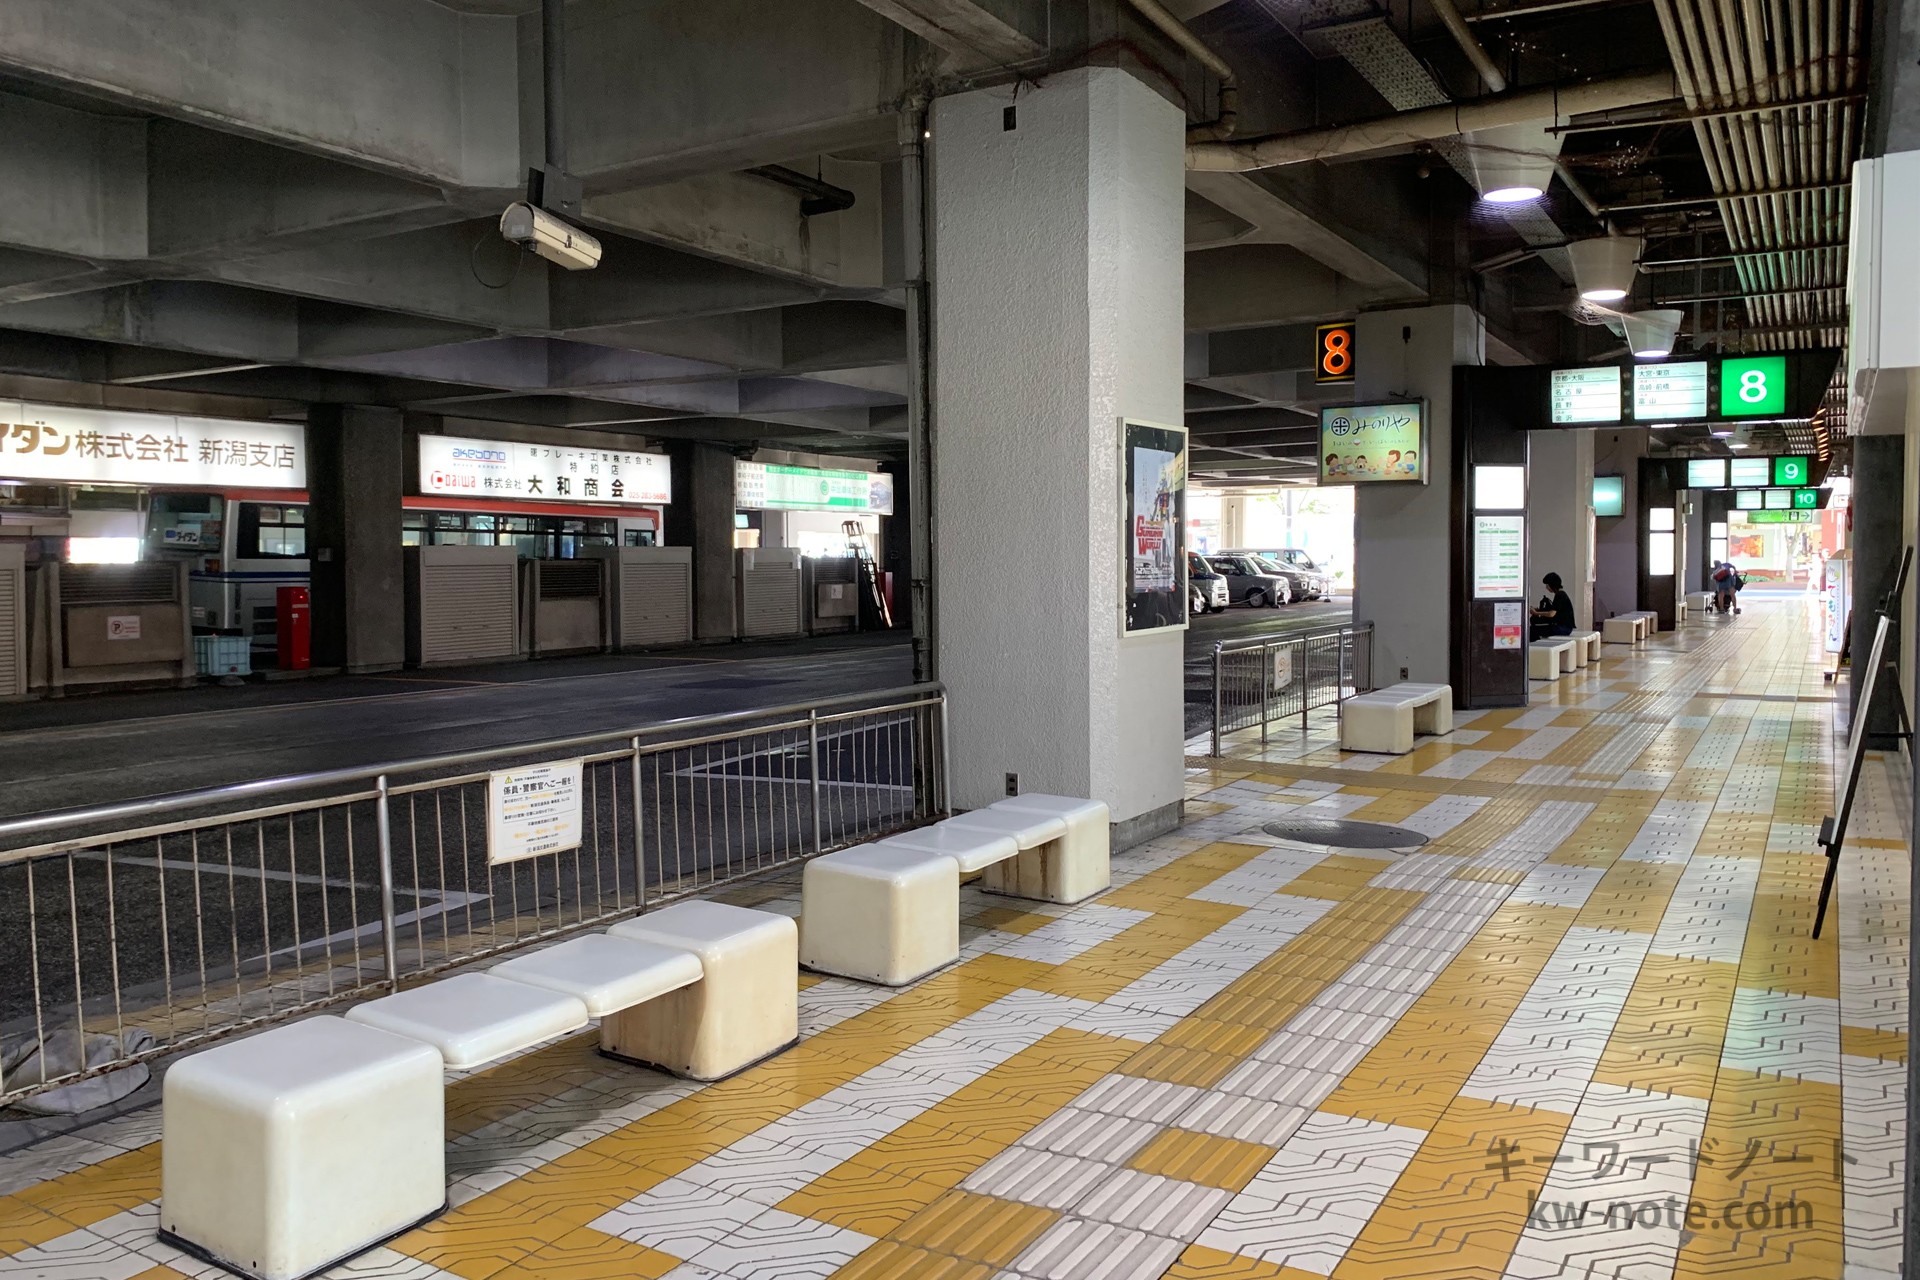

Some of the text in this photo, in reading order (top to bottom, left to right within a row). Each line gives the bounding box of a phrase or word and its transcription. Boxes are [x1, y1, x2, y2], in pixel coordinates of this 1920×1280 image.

[1323, 329, 1351, 375] 8
[1555, 388, 1582, 396] 名古屋
[1739, 370, 1768, 403] 8
[1352, 411, 1411, 436] みのりや
[198, 438, 296, 470] 新潟支店
[569, 462, 620, 476] 特約店
[1784, 463, 1799, 479] 9
[483, 477, 523, 490] 株式会社
[527, 475, 625, 498] 大和商会
[1797, 493, 1814, 504] 10
